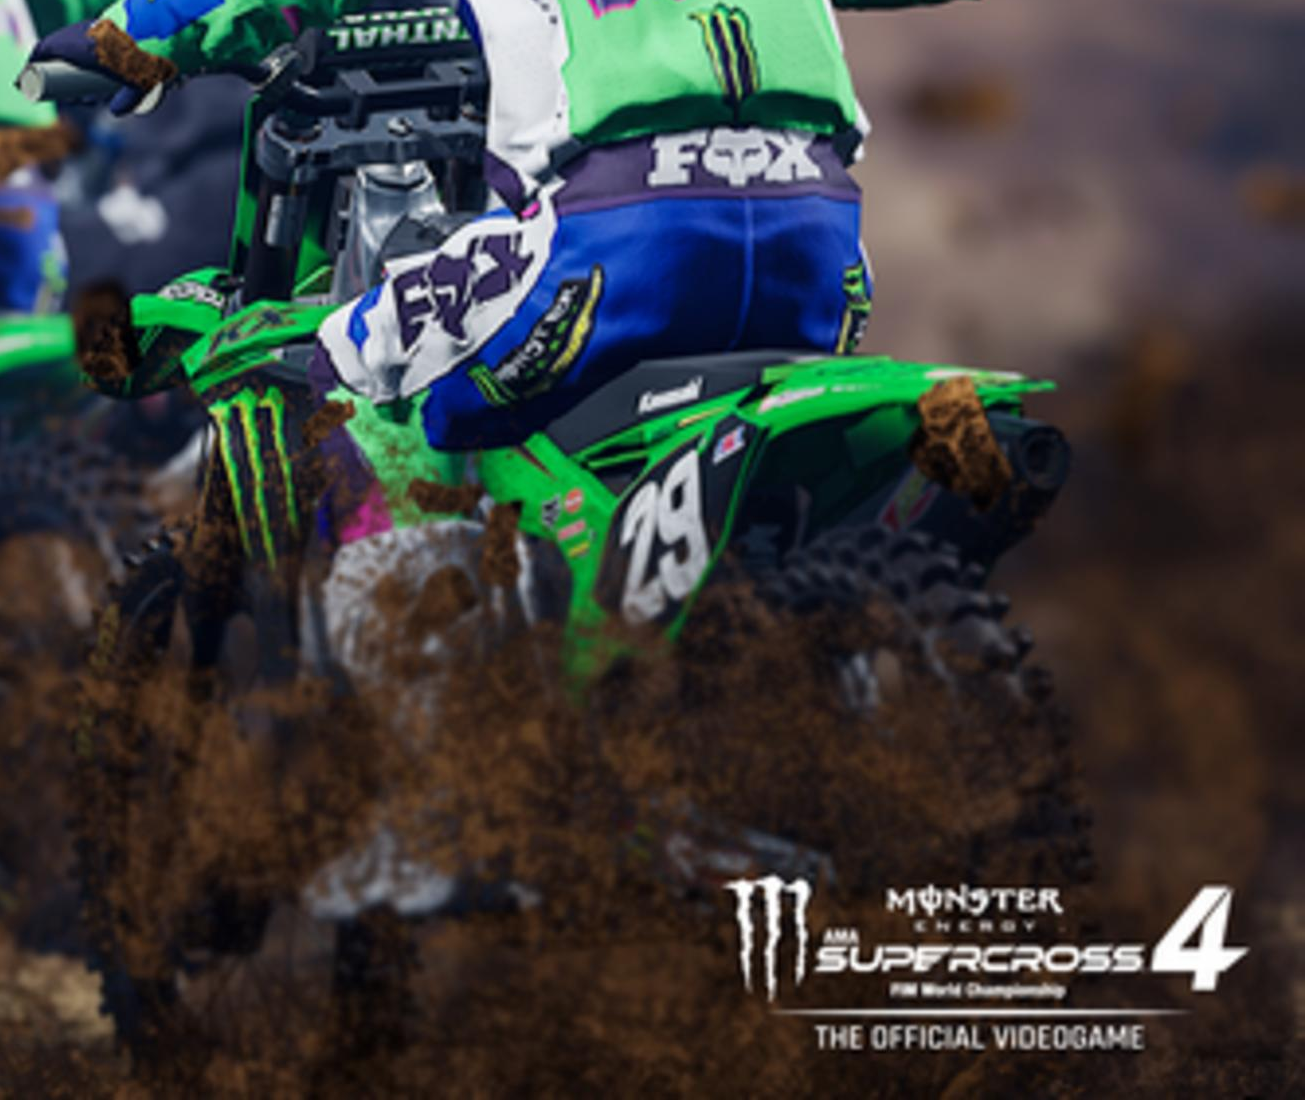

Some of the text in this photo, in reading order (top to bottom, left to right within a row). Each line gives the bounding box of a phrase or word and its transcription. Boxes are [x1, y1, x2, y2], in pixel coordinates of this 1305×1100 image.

[648, 127, 821, 187] FOX
[391, 230, 535, 352] FOX
[620, 449, 711, 625] 29
